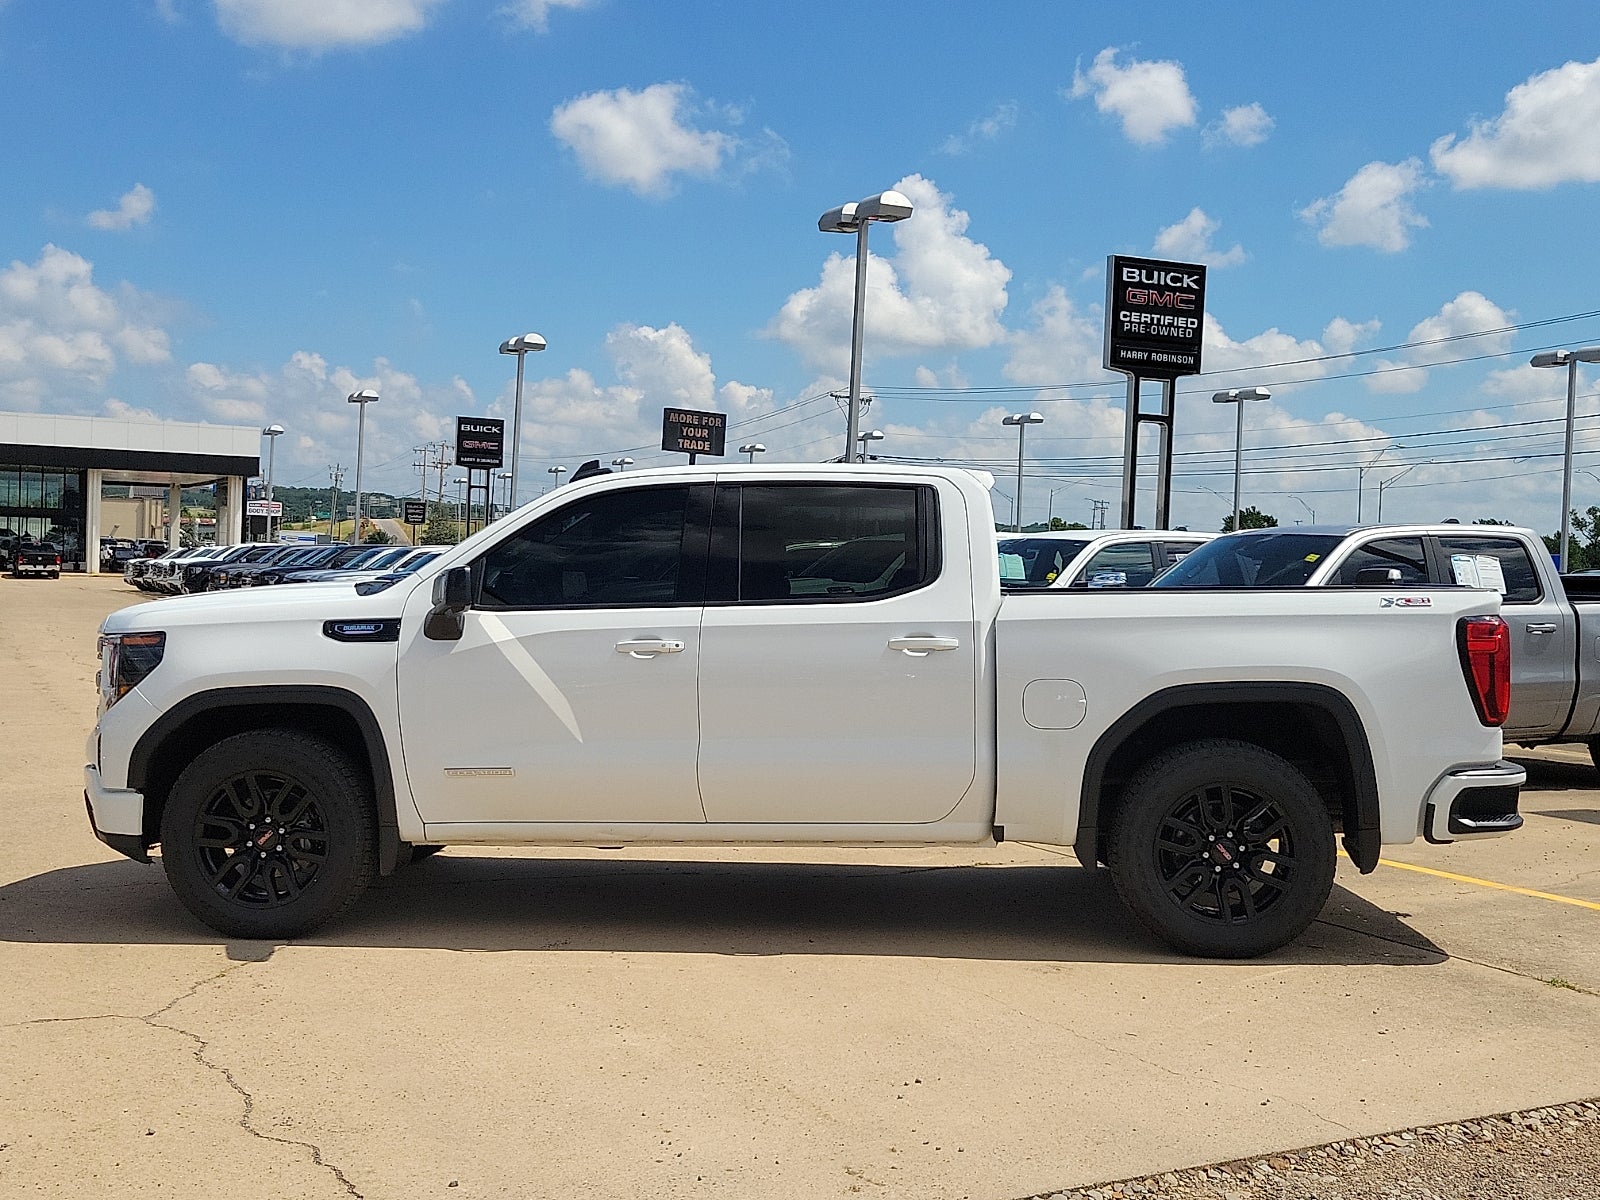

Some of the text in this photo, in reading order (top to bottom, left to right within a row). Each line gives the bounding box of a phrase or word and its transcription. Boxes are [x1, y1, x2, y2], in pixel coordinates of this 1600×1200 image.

[1122, 267, 1200, 290] BUICK
[1126, 287, 1195, 310] GMC
[1119, 310, 1198, 329] CERTIFIED
[1123, 322, 1193, 338] PRE-OWNED
[1120, 349, 1194, 365] HARRY ROBINSON
[669, 412, 722, 427] MORE FOR
[461, 424, 502, 434] BUICK
[681, 426, 709, 439] YOUR
[677, 438, 711, 451] TRADE
